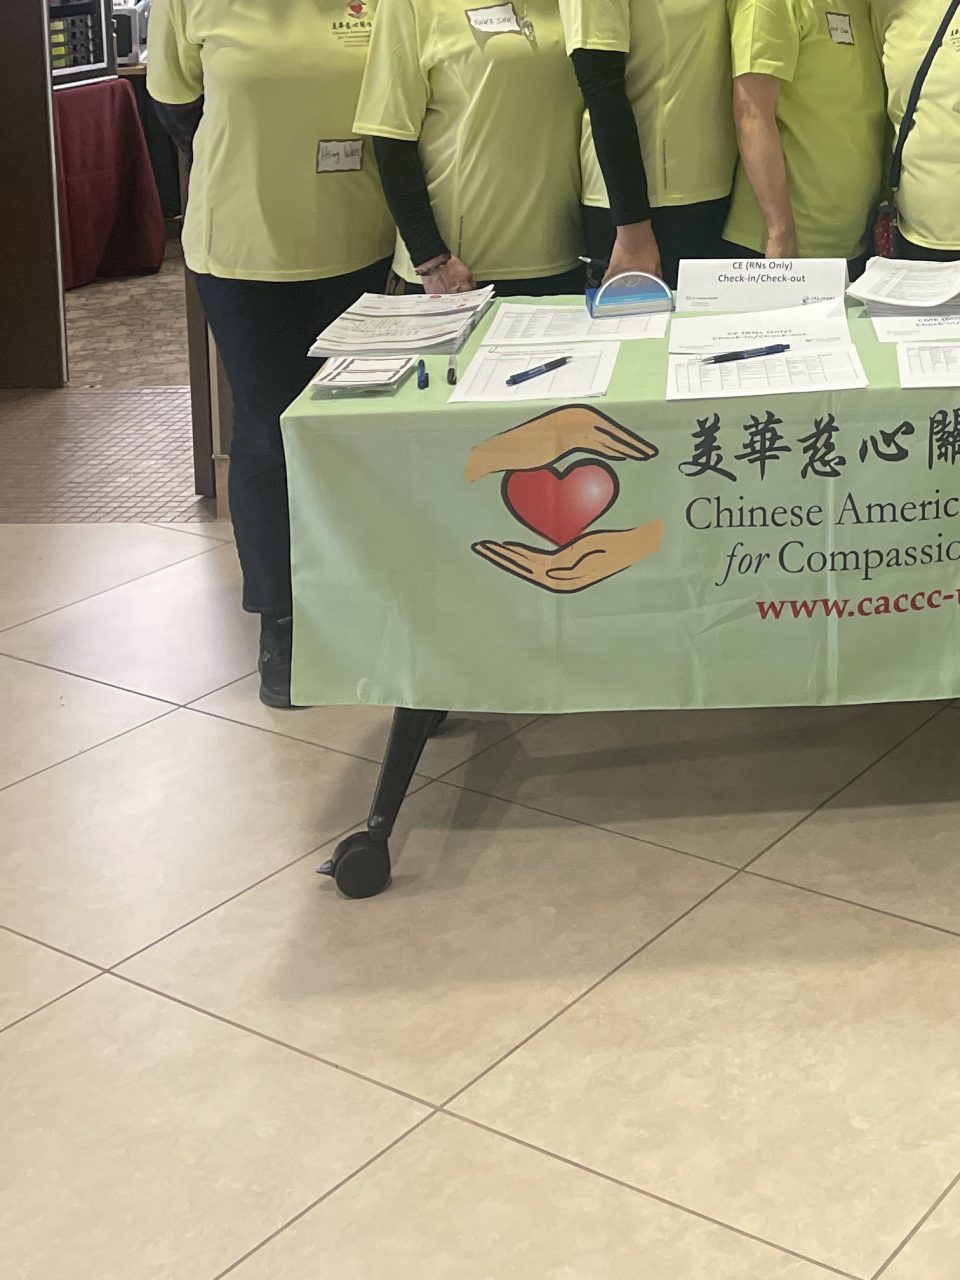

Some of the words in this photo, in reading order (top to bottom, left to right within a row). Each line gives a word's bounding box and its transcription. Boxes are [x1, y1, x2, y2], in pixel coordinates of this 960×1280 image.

[732, 261, 744, 270] CE
[745, 261, 767, 271] (RNs
[768, 261, 793, 272] Only)
[718, 274, 806, 284] Check-in/Check-out
[685, 493, 824, 531] Chinese
[715, 542, 771, 587] for
